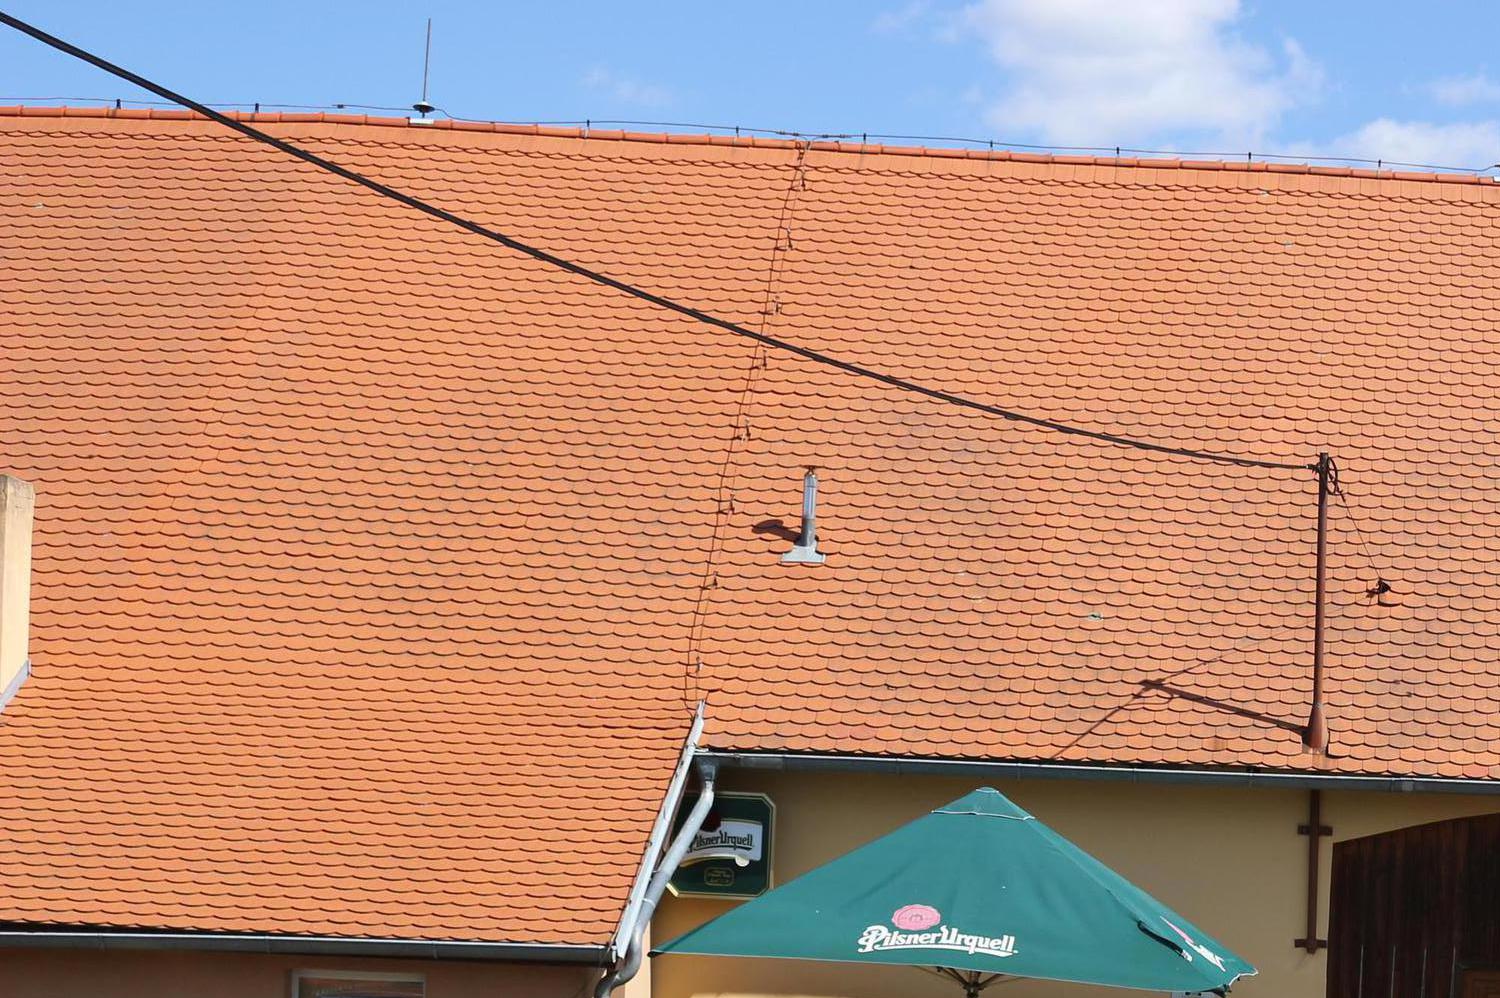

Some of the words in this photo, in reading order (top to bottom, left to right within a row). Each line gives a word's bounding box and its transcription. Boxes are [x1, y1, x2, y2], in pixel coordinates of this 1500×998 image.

[719, 830, 753, 851] Urquell
[858, 925, 942, 953] Pilsner
[939, 925, 1018, 955] Urquell
